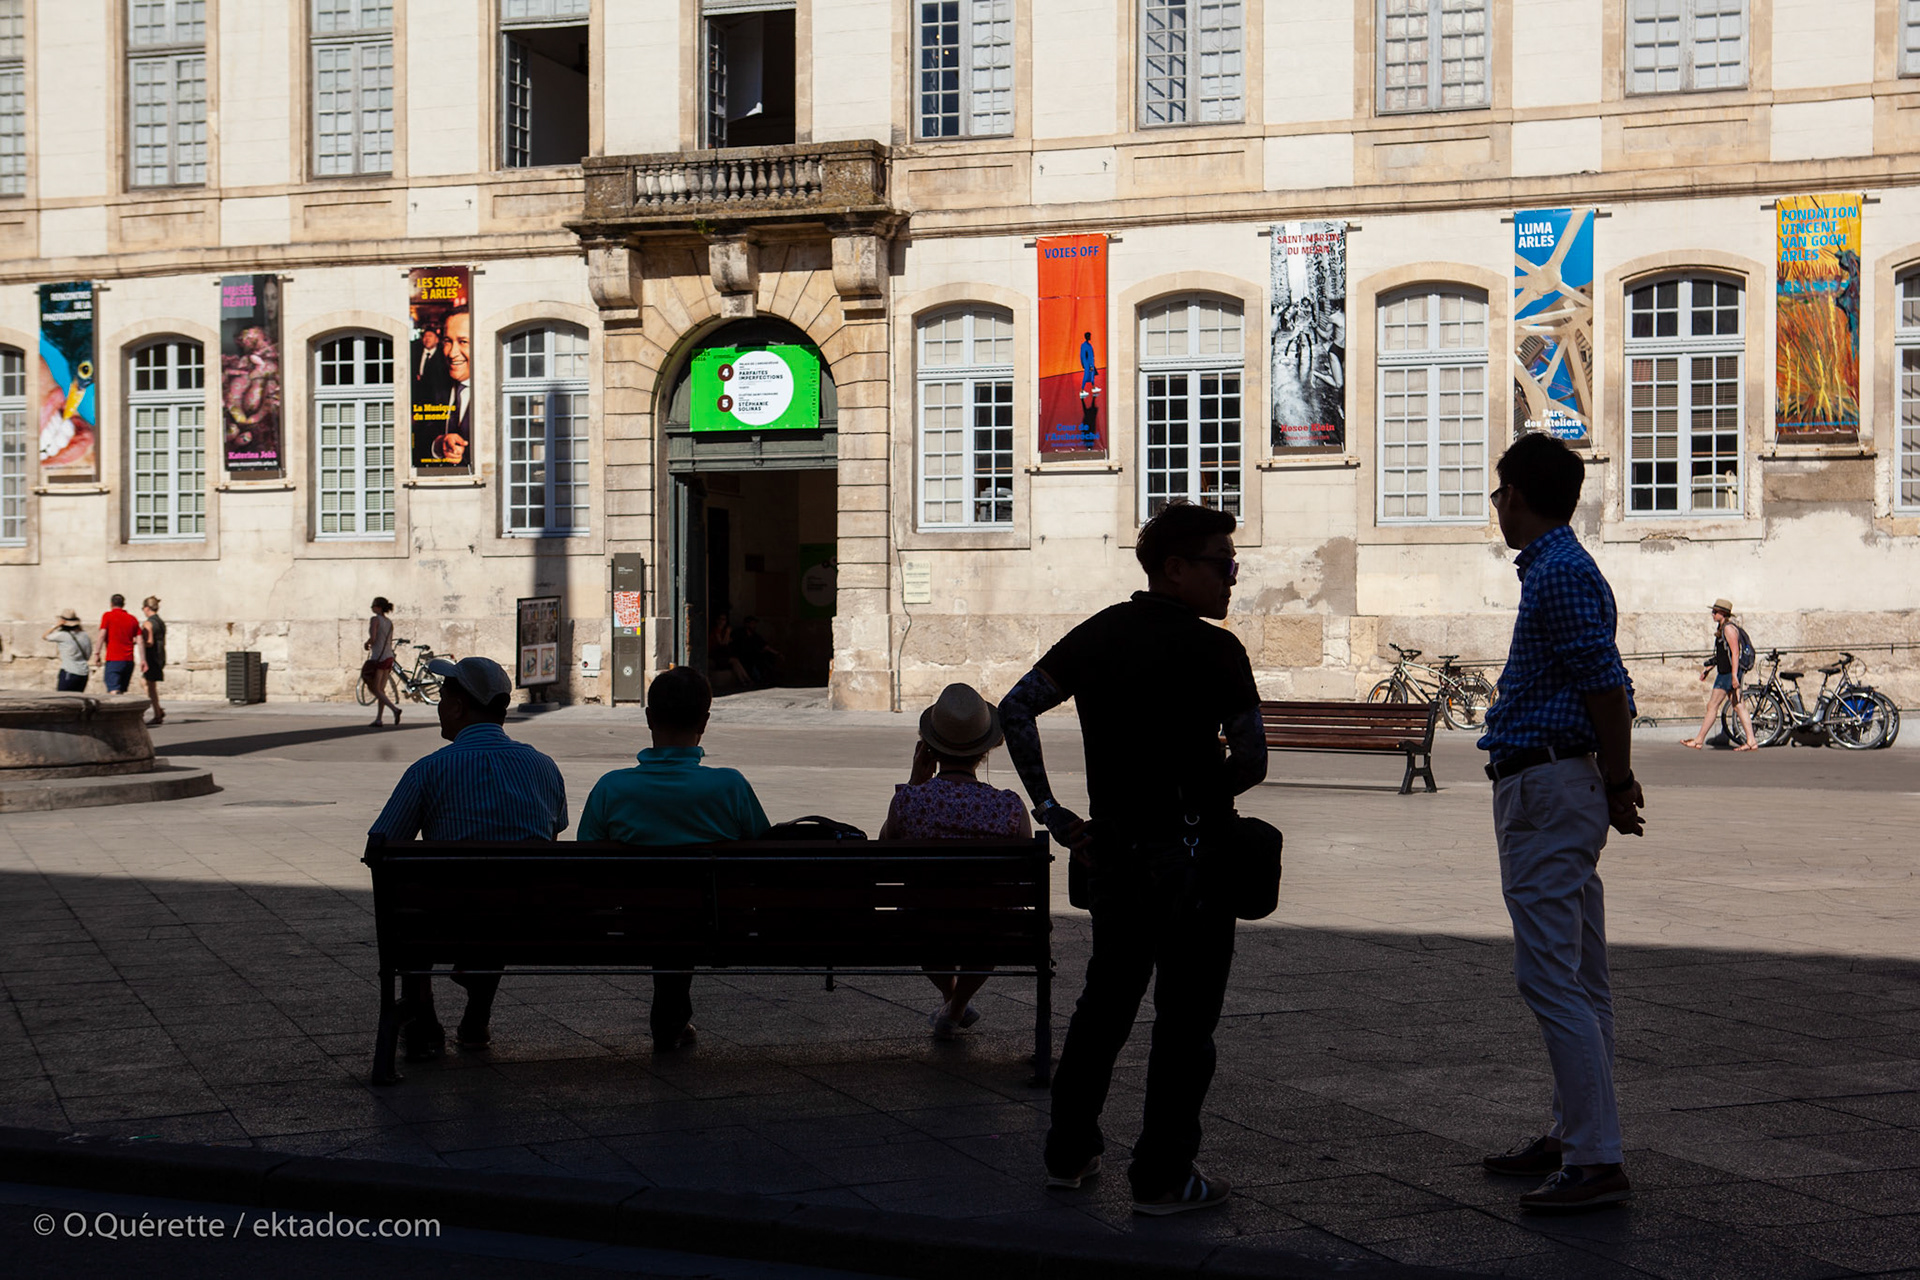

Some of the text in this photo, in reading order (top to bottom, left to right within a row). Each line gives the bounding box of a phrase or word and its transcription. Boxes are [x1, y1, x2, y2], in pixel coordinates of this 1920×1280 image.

[1781, 206, 1857, 222] FONDATION
[1518, 222, 1553, 236] LUMA
[1781, 220, 1838, 235] VINCENT
[1518, 234, 1555, 249] ARLES
[1781, 235, 1807, 249] VAN
[1044, 245, 1099, 259] VOIES OFF
[1287, 246, 1299, 255] DU
[1780, 248, 1820, 263] ARLES
[417, 276, 462, 289] LES SUDS,
[430, 287, 458, 299] ARLES
[722, 367, 730, 378] 4
[722, 398, 729, 409] 5
[1542, 409, 1565, 418] Parc
[1056, 422, 1089, 431] Cour de
[1524, 418, 1582, 428] des Ateliers
